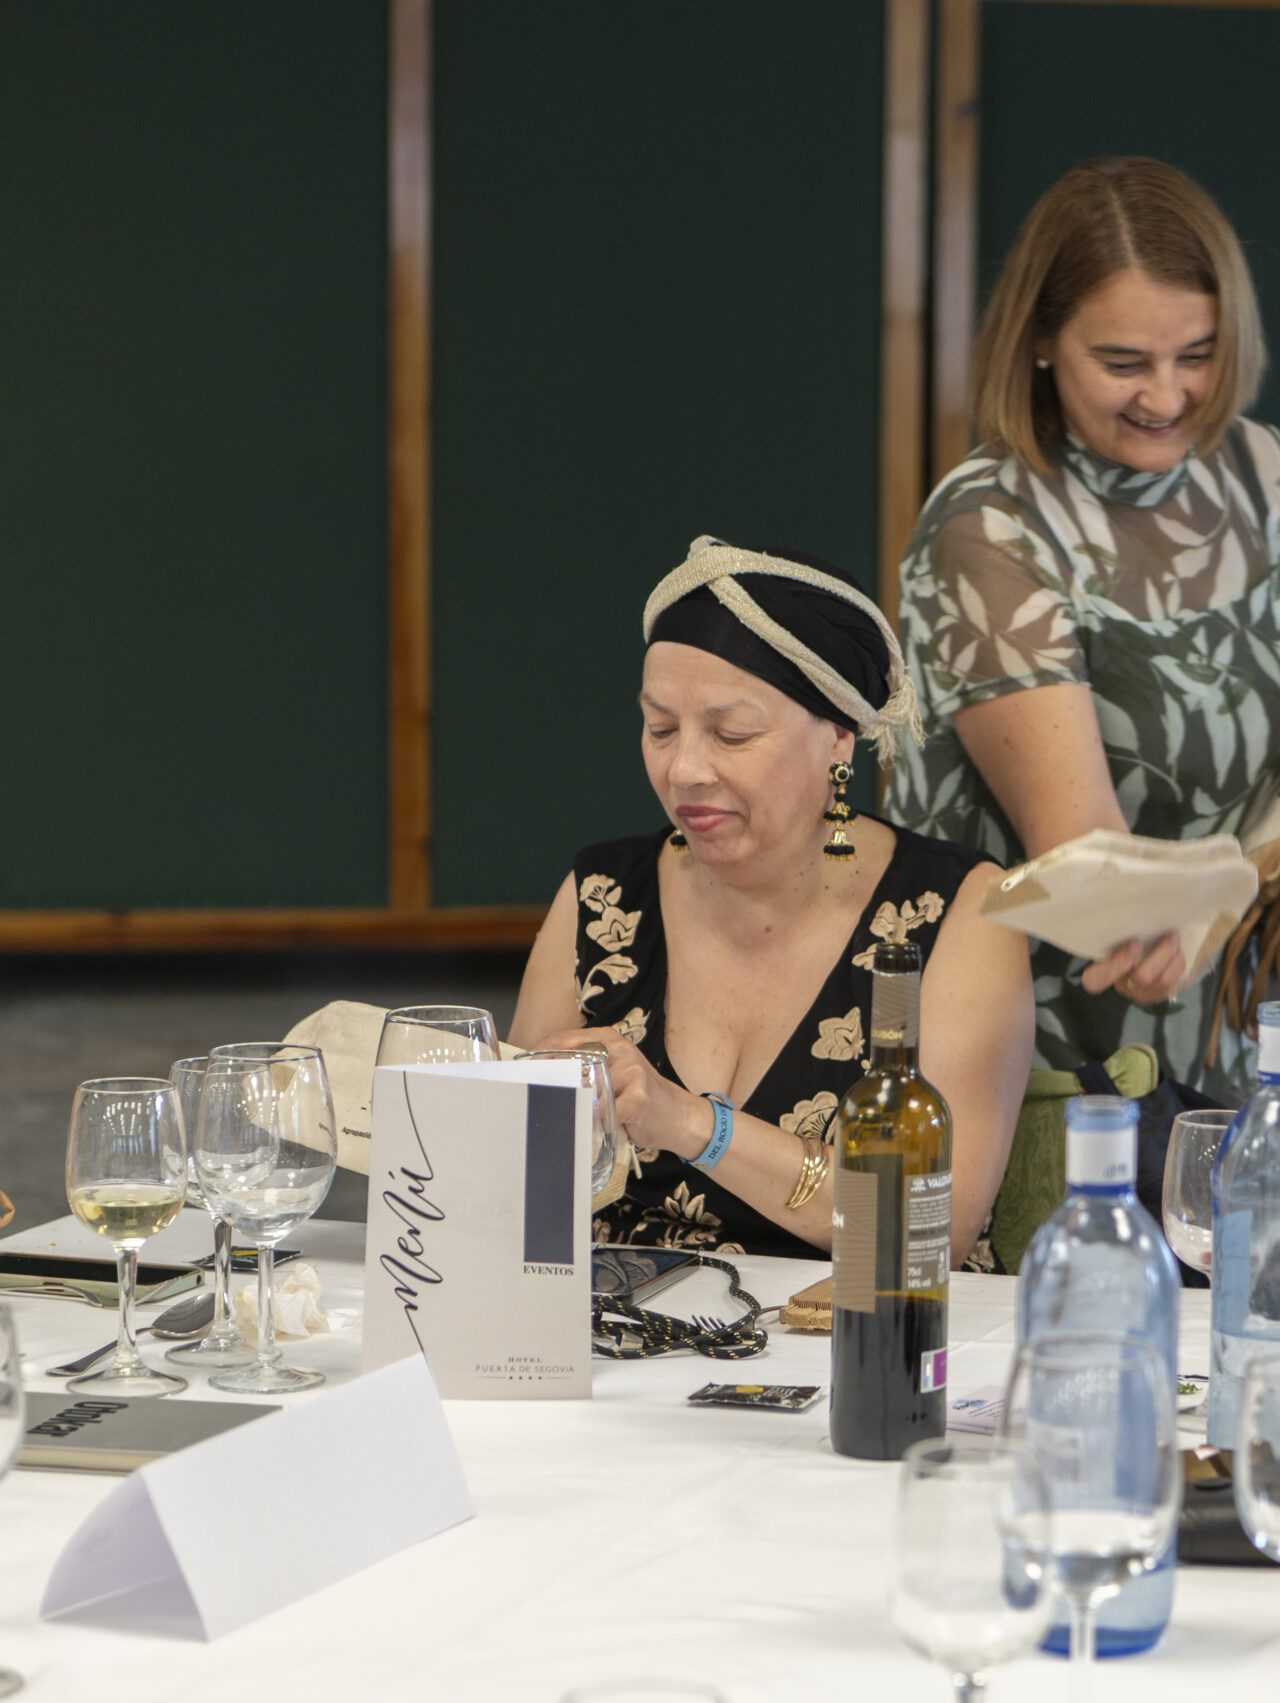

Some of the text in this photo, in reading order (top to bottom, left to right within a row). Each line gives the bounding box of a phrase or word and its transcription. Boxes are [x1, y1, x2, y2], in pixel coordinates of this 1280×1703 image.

[522, 1264, 575, 1277] EVENTOS
[507, 1356, 544, 1364] HOTEL
[475, 1364, 576, 1374] PUERTA DE SEGOVIA
